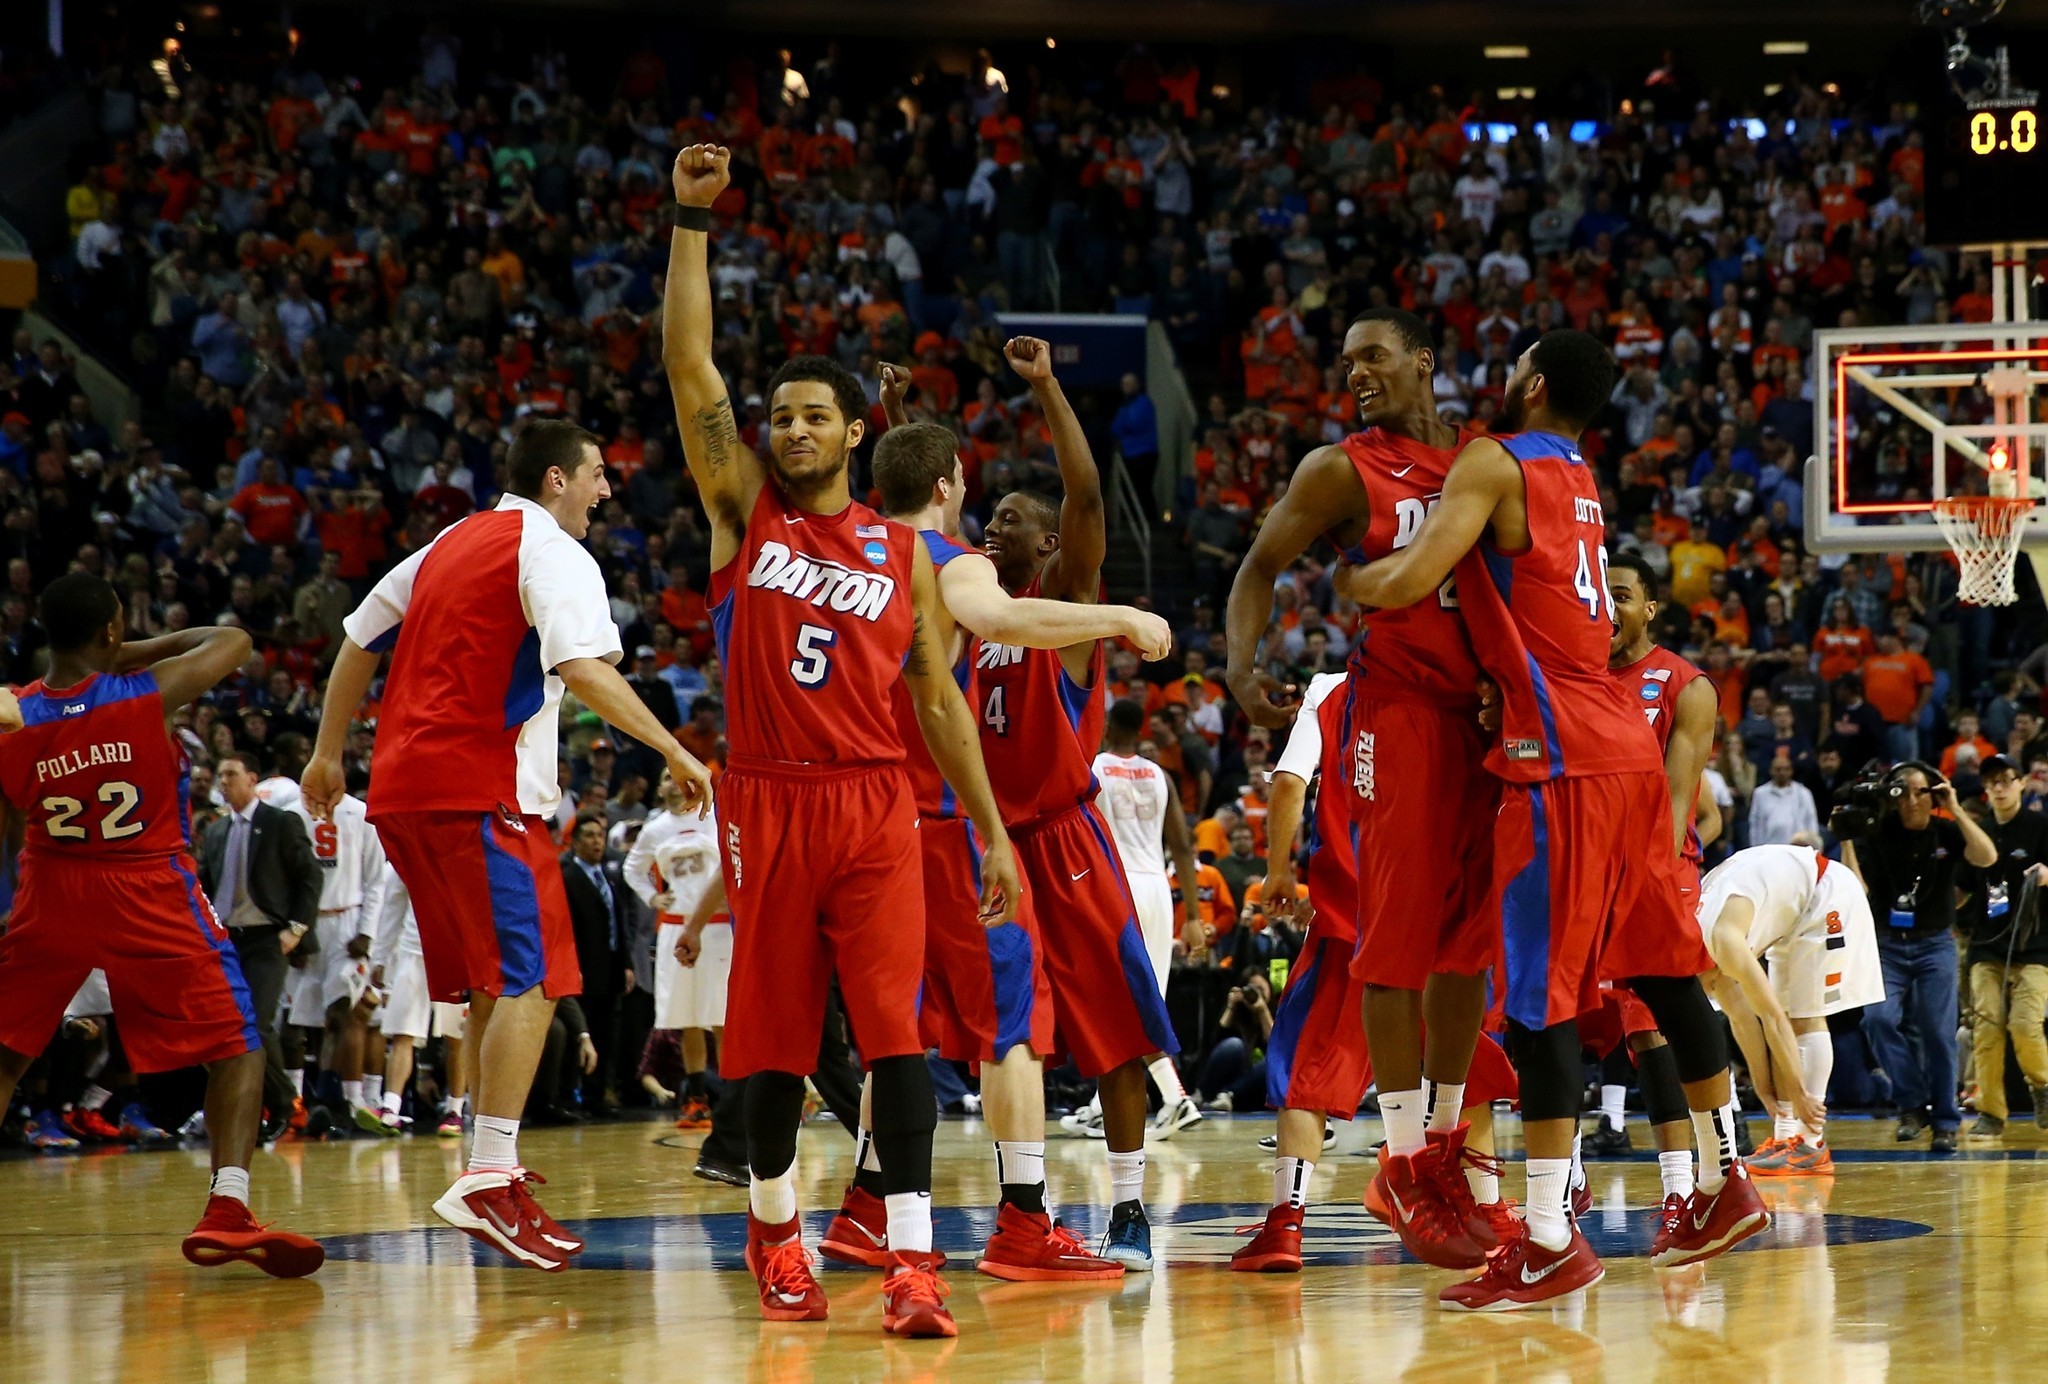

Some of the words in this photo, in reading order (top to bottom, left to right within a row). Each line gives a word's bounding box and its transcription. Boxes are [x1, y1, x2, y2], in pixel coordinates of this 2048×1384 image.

[1970, 110, 2036, 155] 0.0
[747, 540, 895, 622] DAYTON
[790, 623, 834, 685] 5
[36, 741, 133, 783] POLLARD
[1354, 729, 1375, 802] FLYERS
[1520, 742, 1537, 751] 2XL
[41, 781, 144, 840] 22
[314, 823, 338, 858] S
[1825, 910, 1843, 935] S
